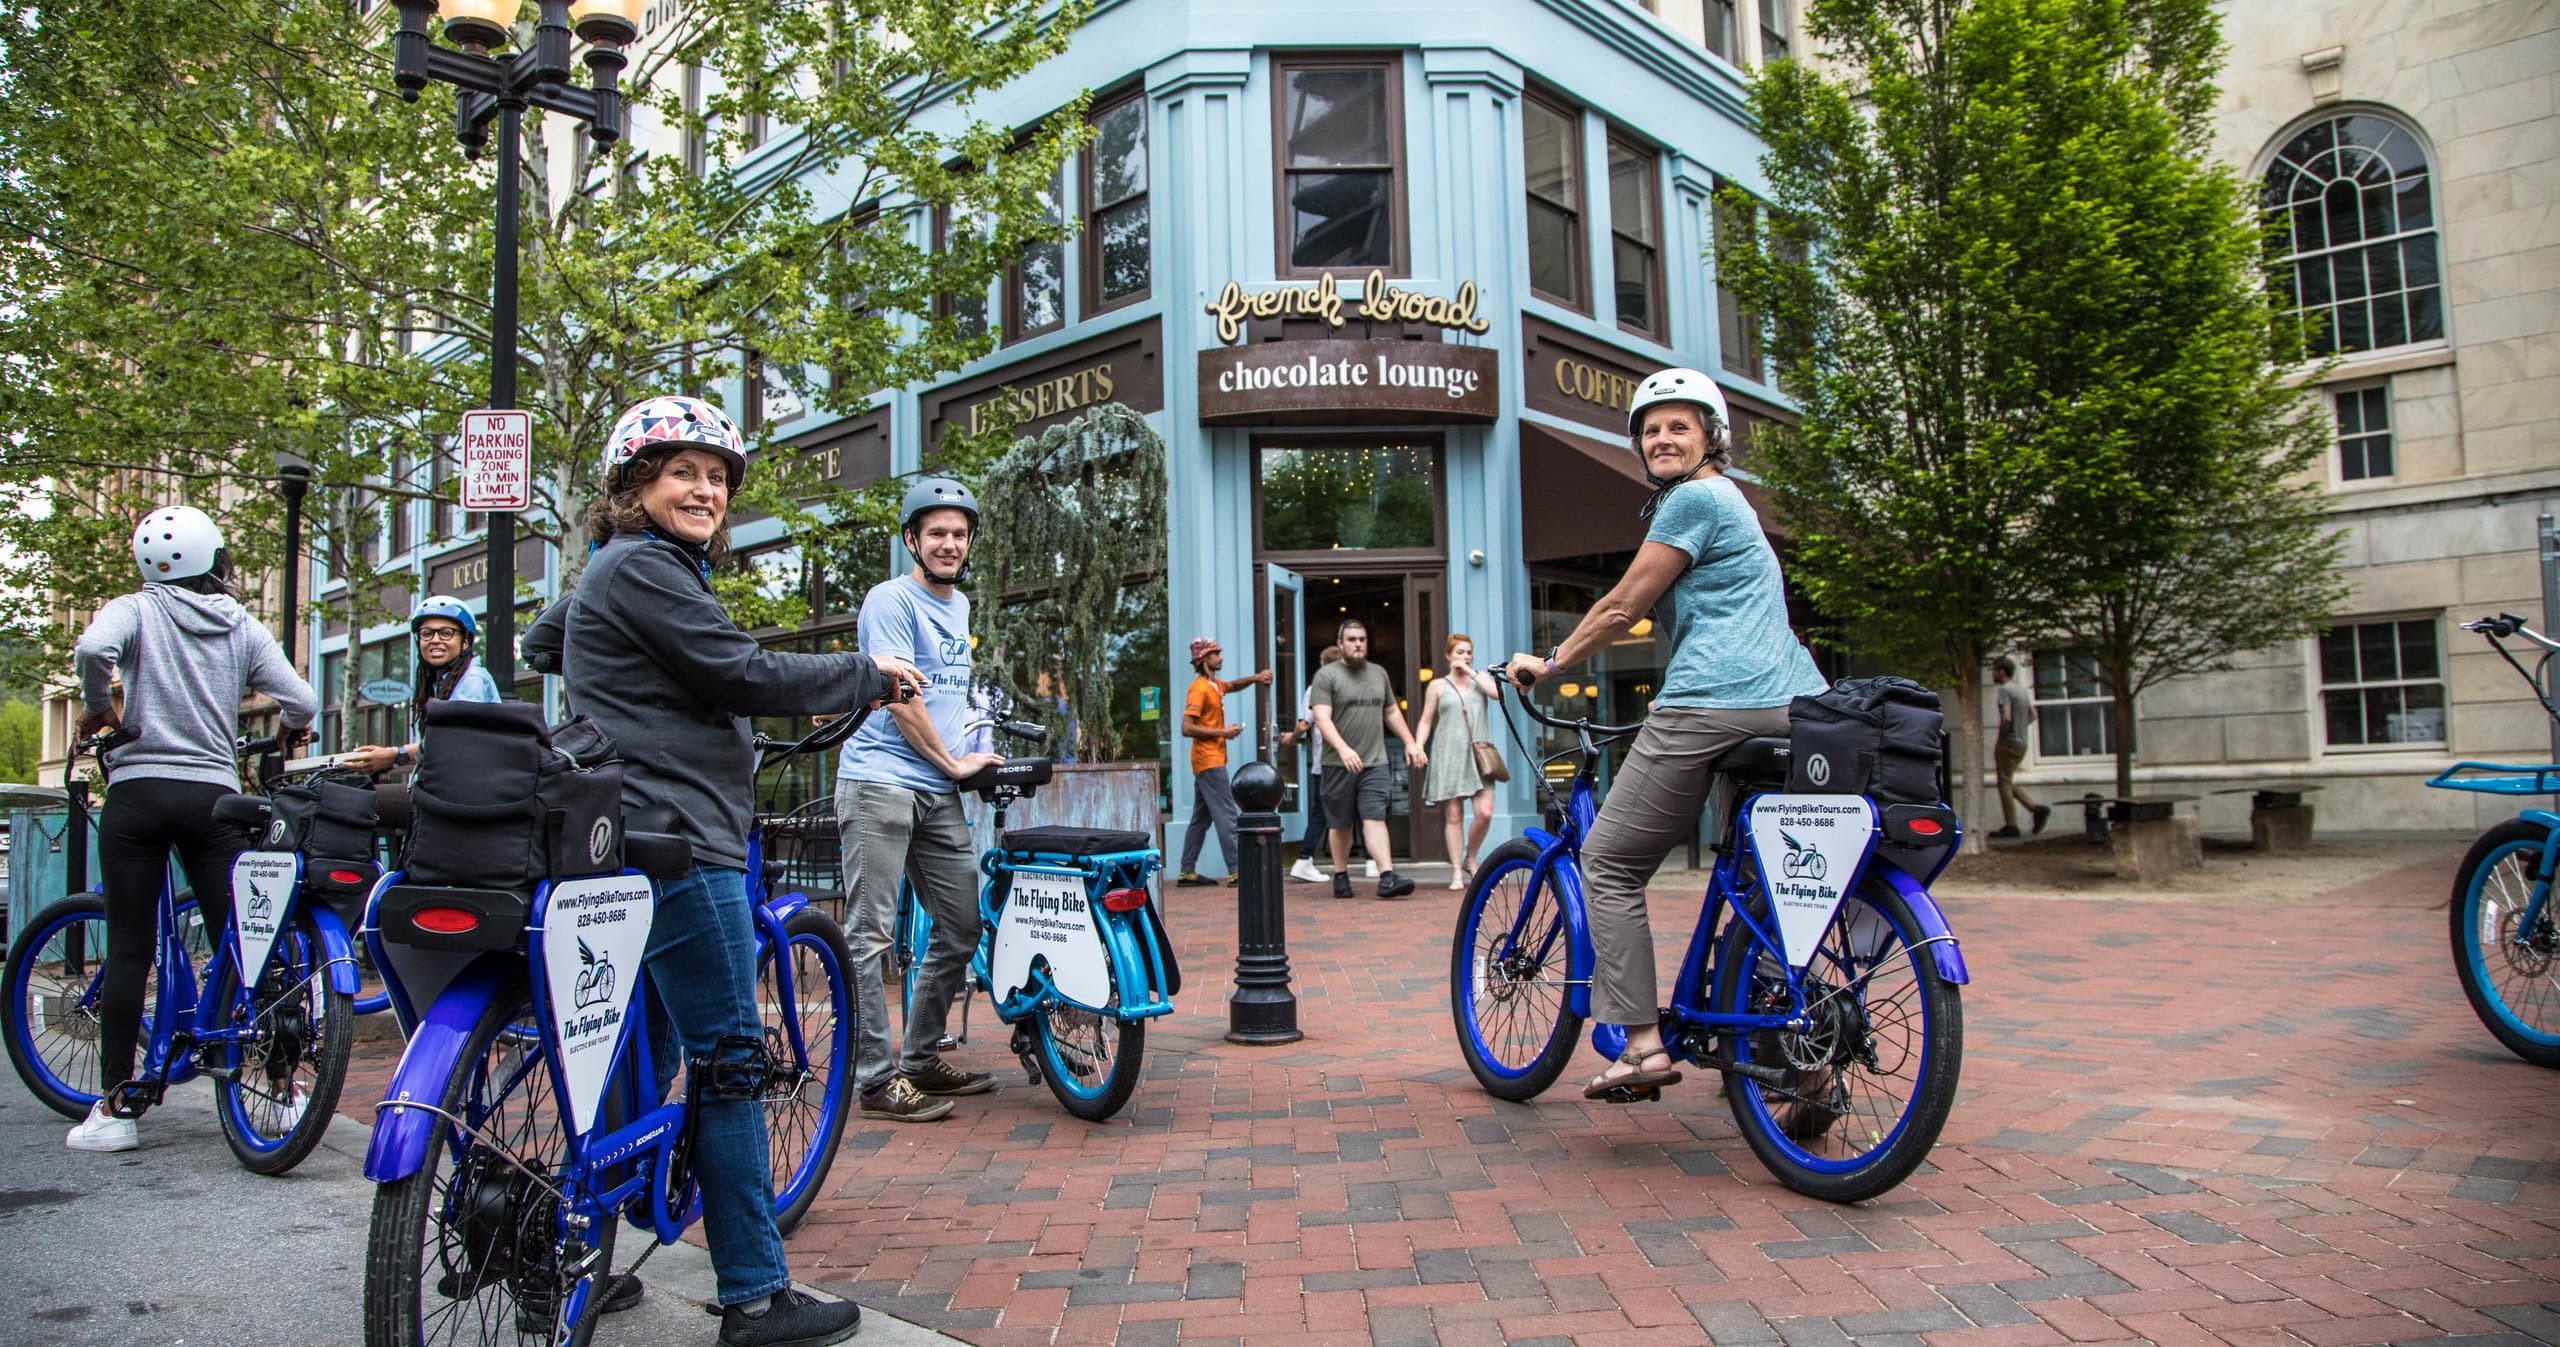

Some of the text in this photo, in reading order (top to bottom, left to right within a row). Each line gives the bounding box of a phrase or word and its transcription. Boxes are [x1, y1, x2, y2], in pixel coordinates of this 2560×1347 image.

[1205, 268, 1490, 342] french broad
[1219, 355, 1479, 398] chocolate lounge
[1555, 358, 1639, 412] COFF
[487, 417, 506, 431] NO
[468, 433, 524, 448] PARKING
[469, 449, 523, 460] LOADING
[481, 461, 511, 471] ZONE
[473, 472, 519, 483] 30 MIN
[478, 484, 512, 495] LIMIT
[453, 563, 472, 589] ICE
[931, 673, 947, 685] The
[1756, 803, 1861, 815] www.FlyingBikeTours.com
[1780, 817, 1835, 827] 828-450-8686
[1775, 882, 1838, 901] The Flying Bike
[557, 889, 649, 911] www.FlyingBikeTours.com
[1013, 887, 1085, 915] The Flying Bike
[577, 909, 627, 928] 828-450-8686
[1015, 916, 1086, 931] www.FlyingBikeTours.com
[564, 1006, 621, 1040] The Flying Bike
